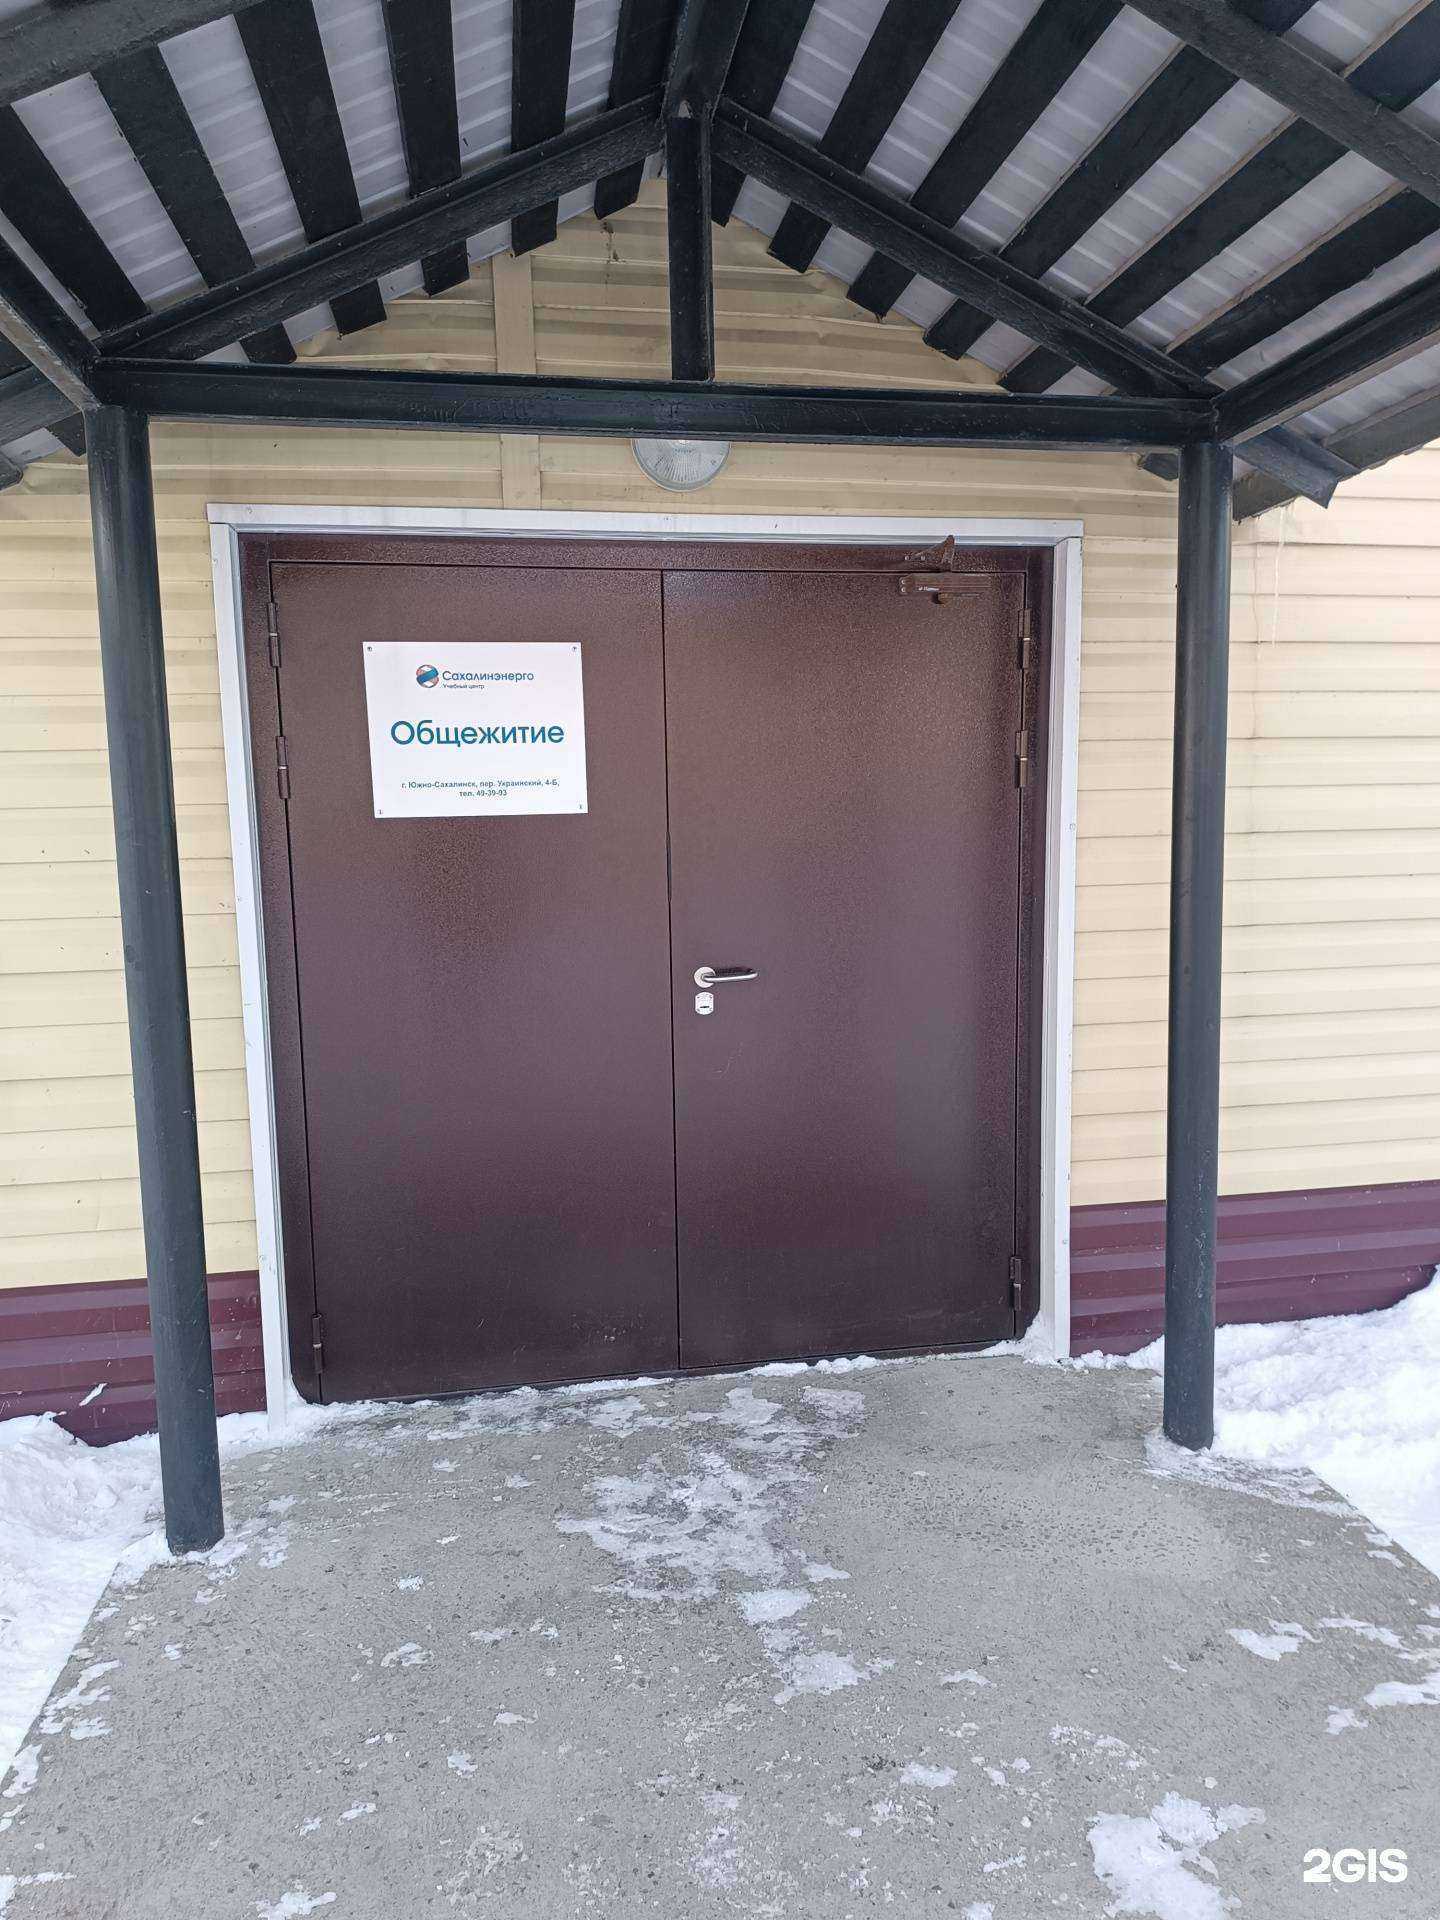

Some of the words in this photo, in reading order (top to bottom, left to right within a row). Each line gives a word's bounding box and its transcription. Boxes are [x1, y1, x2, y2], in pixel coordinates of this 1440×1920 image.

[442, 670, 535, 683] Сахалинэнерго
[390, 719, 565, 748] Общежитие
[408, 781, 478, 789] Южно-Сахалинск,
[479, 780, 496, 788] пер.
[497, 778, 544, 788] Украинский,
